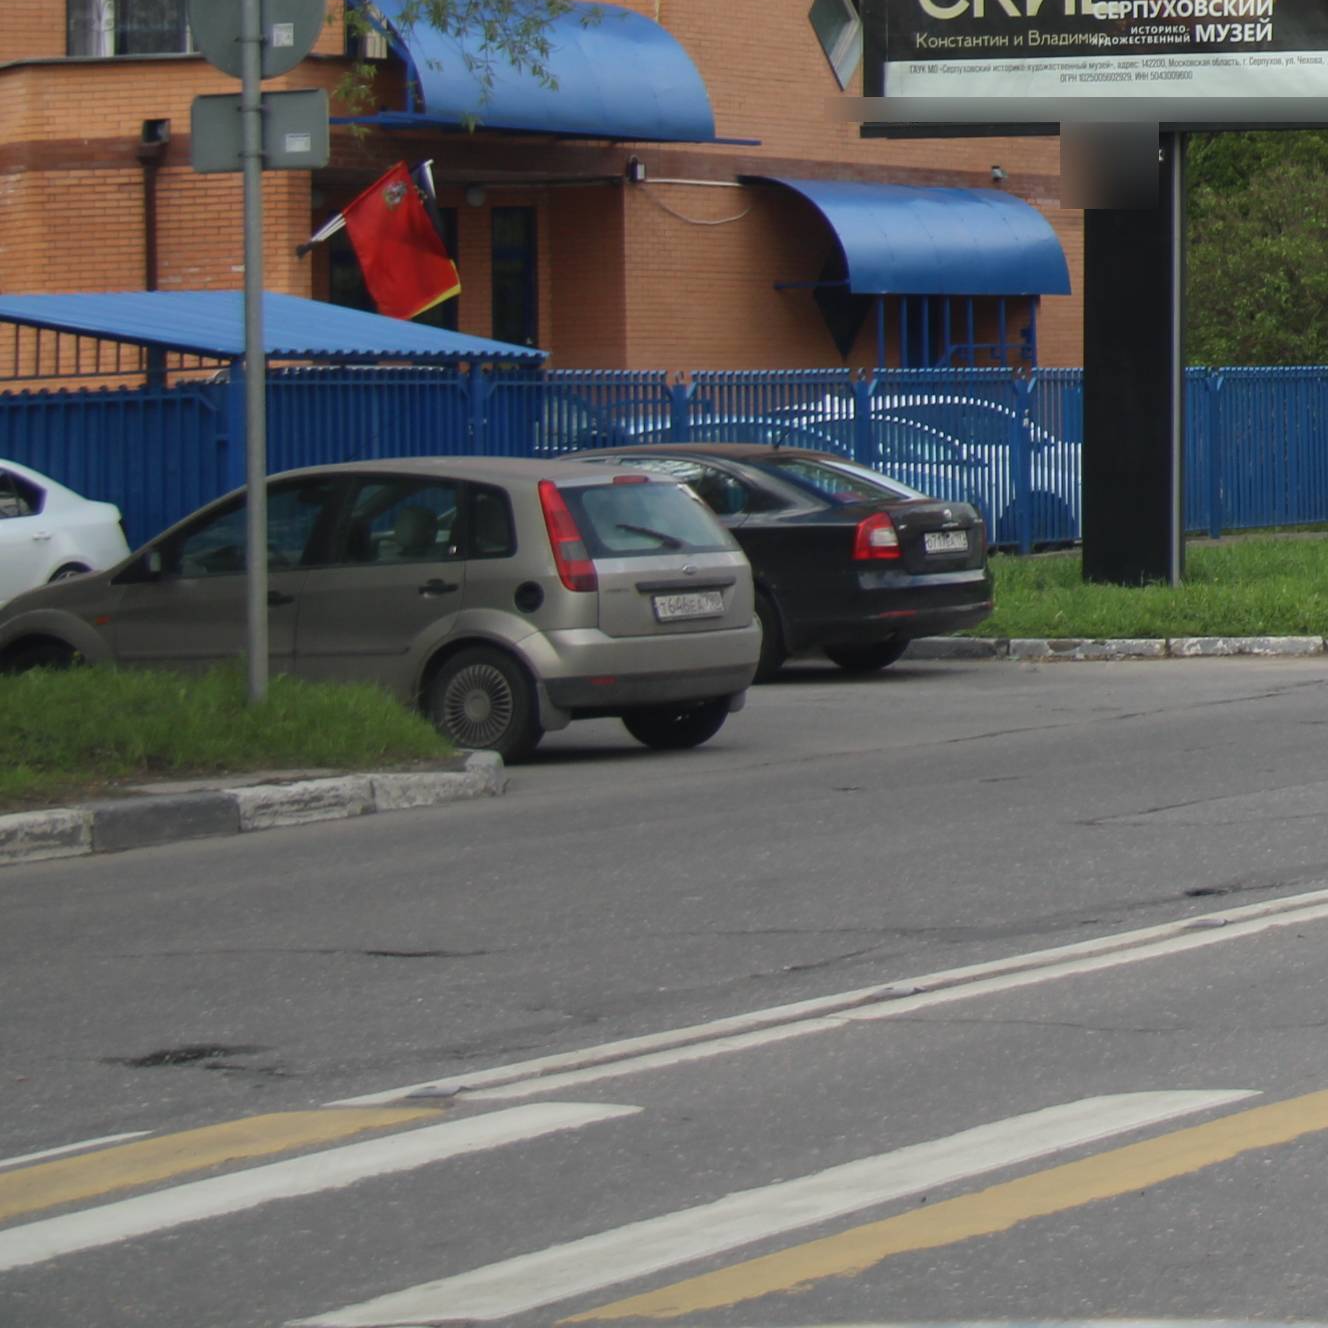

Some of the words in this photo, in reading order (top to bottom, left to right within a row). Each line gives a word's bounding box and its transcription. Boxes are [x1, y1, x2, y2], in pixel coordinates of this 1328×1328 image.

[916, 32, 1009, 48] Константин
[1014, 34, 1024, 46] и
[1195, 17, 1273, 43] МУЗЕЙ
